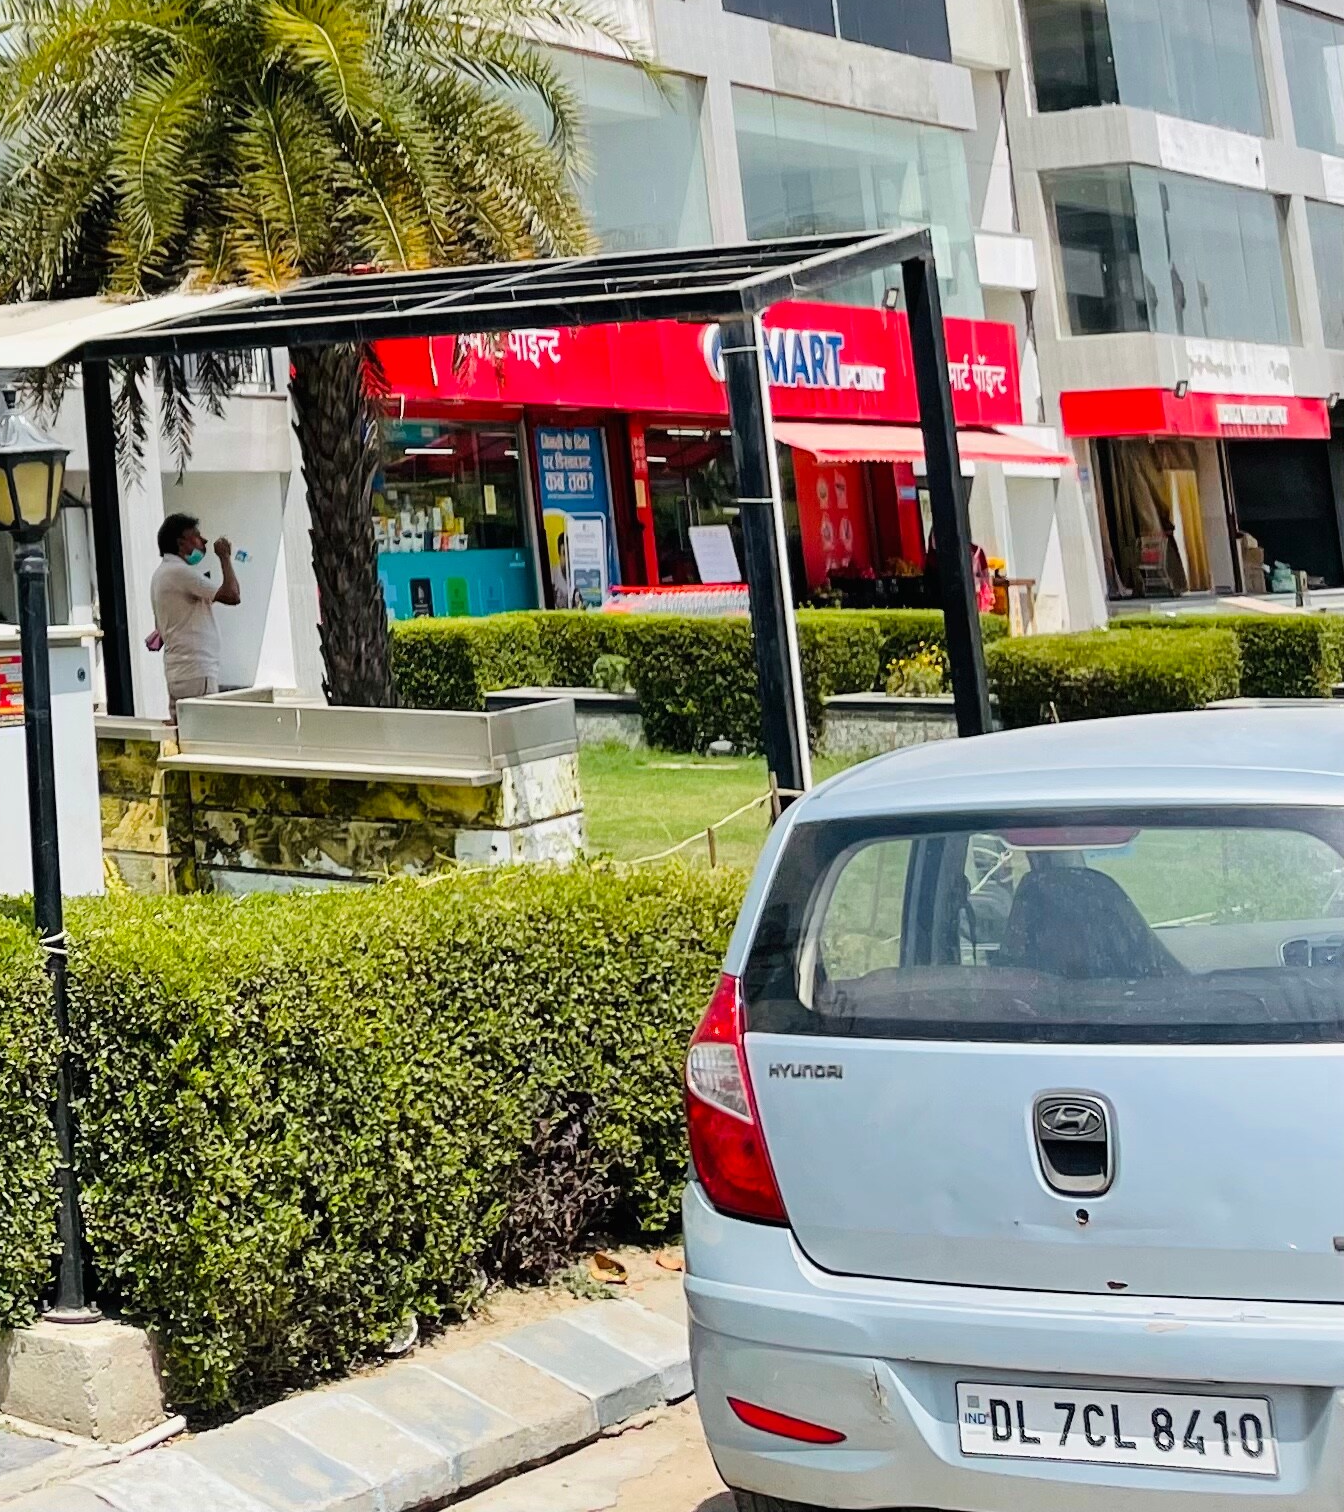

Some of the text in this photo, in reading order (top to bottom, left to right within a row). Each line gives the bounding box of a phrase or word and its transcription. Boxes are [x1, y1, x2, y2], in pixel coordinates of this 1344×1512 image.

[768, 1062, 844, 1080] HYUNDAI
[964, 1412, 987, 1425] IND
[989, 1398, 1263, 1460] DL 7CL 8410
